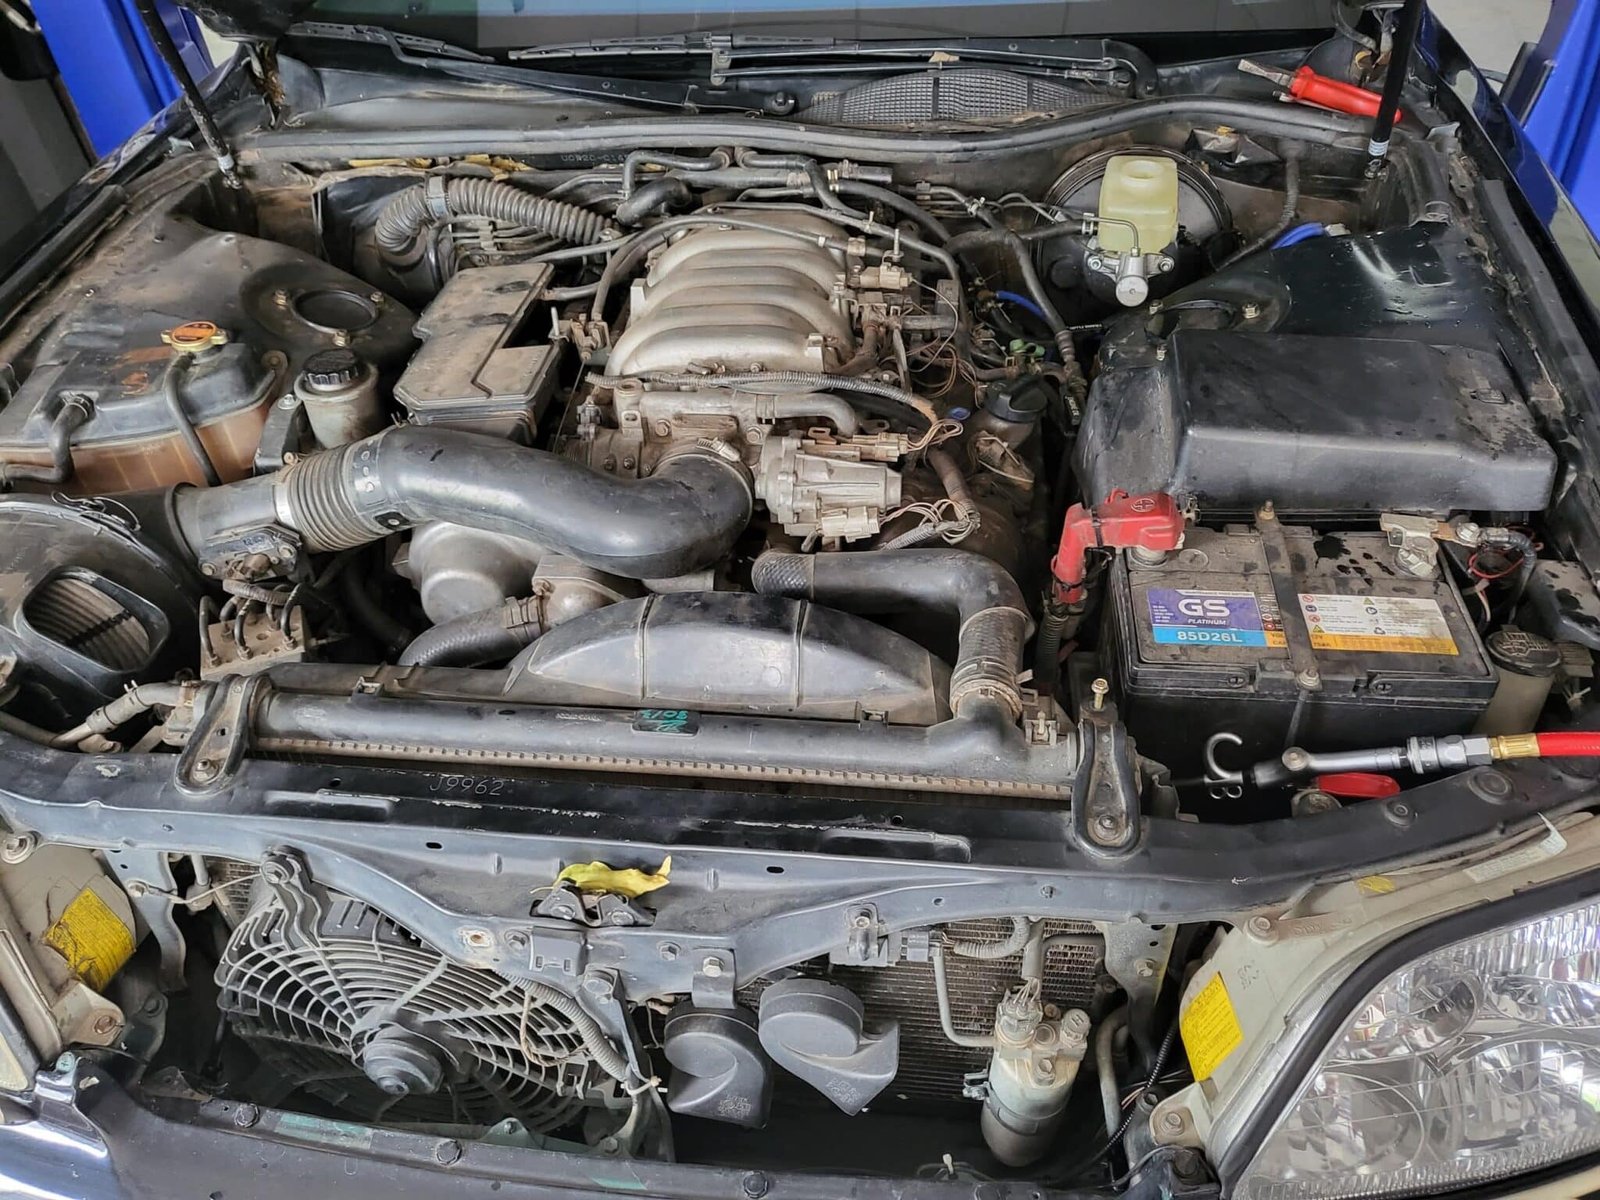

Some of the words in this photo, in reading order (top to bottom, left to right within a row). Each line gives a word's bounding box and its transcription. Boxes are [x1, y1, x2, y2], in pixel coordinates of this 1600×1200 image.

[1178, 598, 1231, 617] GS
[1177, 631, 1243, 643] 85D26L
[429, 776, 504, 796] J9962
